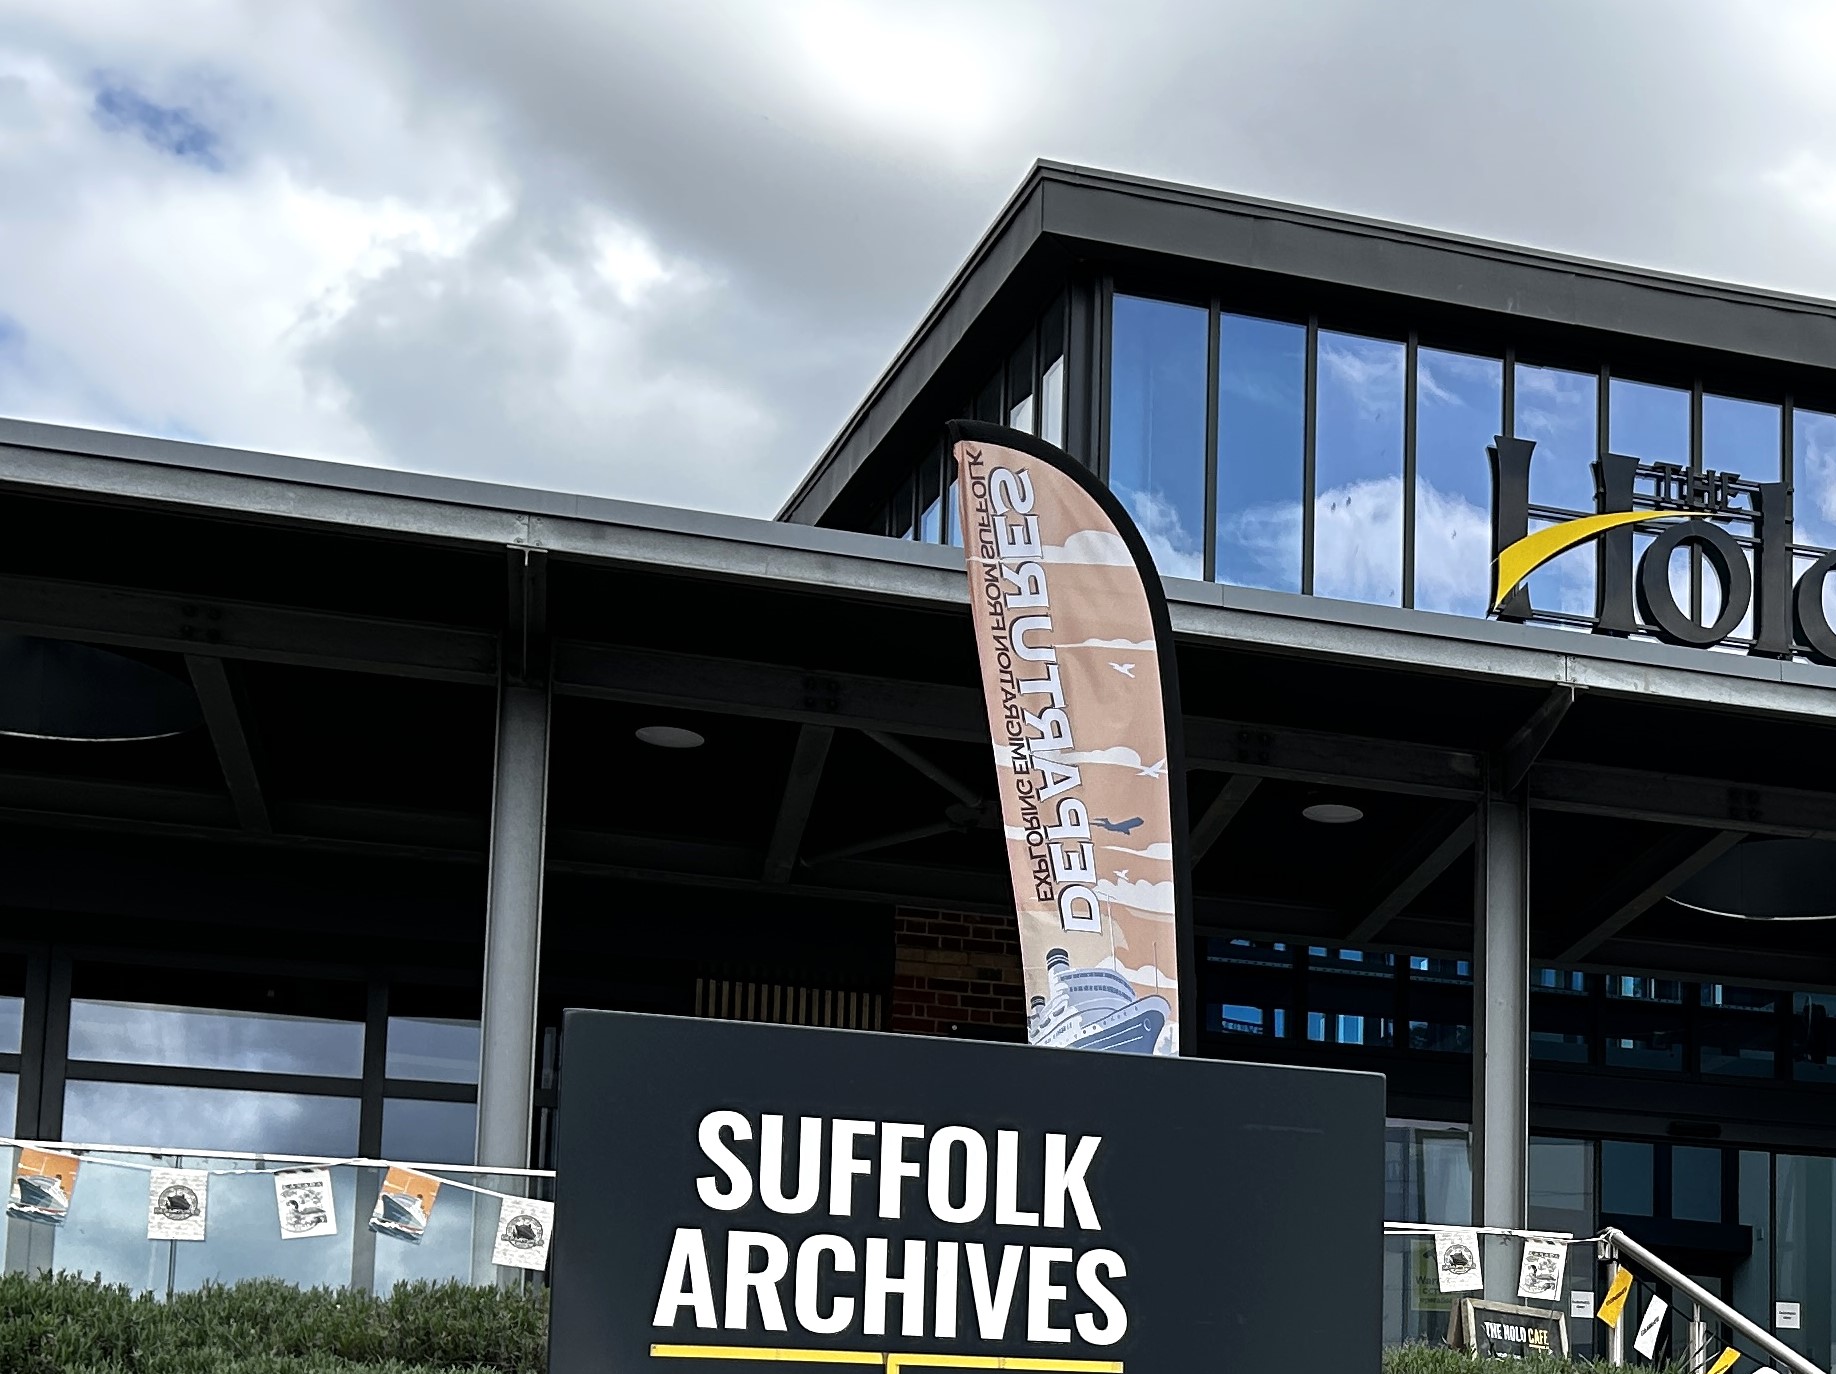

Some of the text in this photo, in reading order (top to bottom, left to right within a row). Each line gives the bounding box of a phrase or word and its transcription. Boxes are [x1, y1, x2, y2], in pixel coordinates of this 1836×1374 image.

[1650, 461, 1742, 513] THE
[696, 1110, 1102, 1231] SUFFOLK
[652, 1227, 1128, 1346] ARCHIVES
[1484, 1321, 1502, 1339] THE
